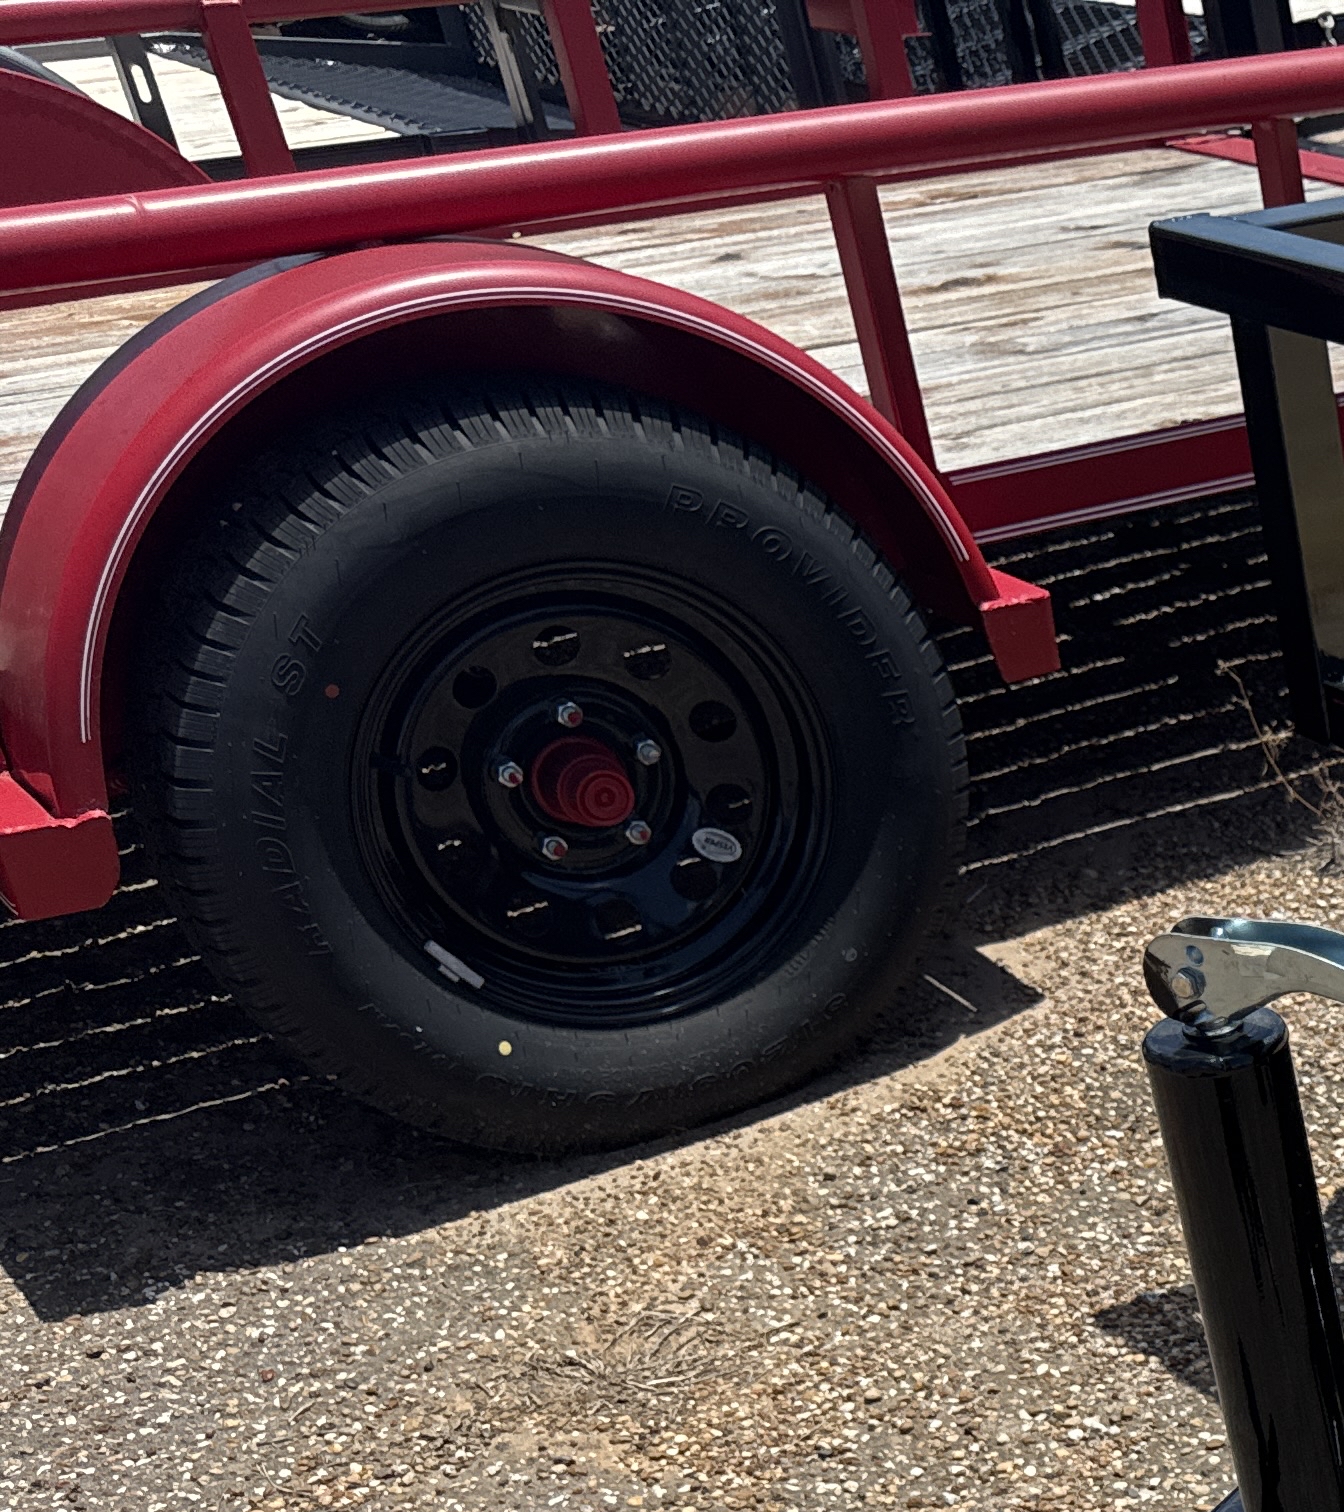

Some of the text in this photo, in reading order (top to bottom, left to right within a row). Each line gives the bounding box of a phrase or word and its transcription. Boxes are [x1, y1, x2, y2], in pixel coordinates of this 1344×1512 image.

[666, 484, 915, 727] PROVIDER
[250, 611, 333, 958] RADIAL ST
